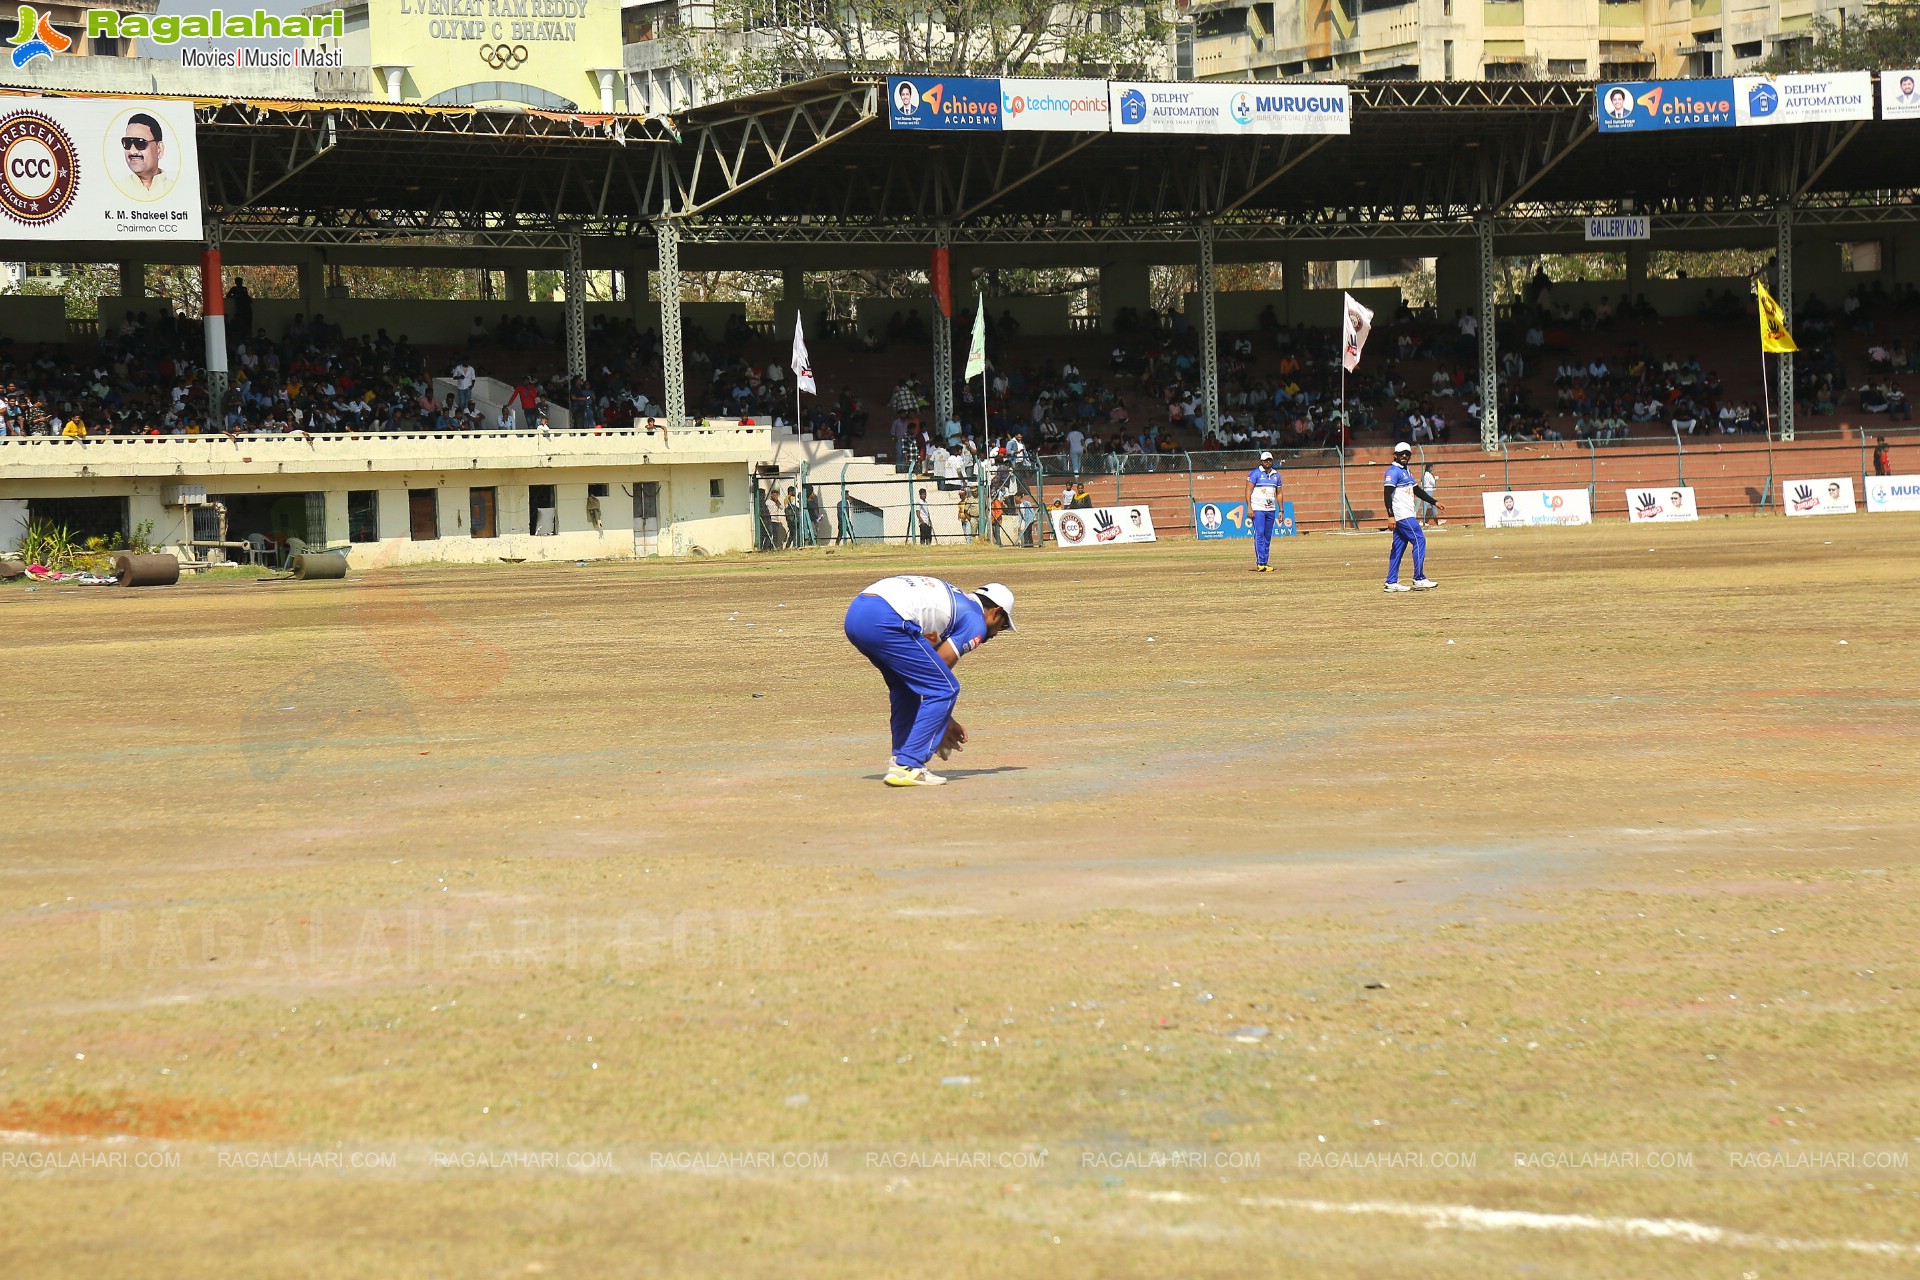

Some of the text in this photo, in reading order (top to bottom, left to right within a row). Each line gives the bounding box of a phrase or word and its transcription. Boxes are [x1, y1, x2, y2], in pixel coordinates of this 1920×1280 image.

[488, 0, 528, 17] RAM
[531, 0, 587, 18] REDDY
[511, 21, 576, 41] BHAVAN
[1782, 83, 1828, 95] DELPHY
[1026, 95, 1108, 115] technopaints
[1151, 93, 1190, 103] DELPHY
[1256, 96, 1344, 113] MURUGUN
[1784, 95, 1862, 108] AUTOMATION
[1153, 107, 1219, 117] AUTOMATION
[1664, 114, 1729, 125] ACADEMY
[945, 115, 998, 125] ACADEMY
[11, 158, 51, 179] CCC
[1, 183, 28, 209] CRICKET
[48, 187, 63, 204] CUP
[104, 210, 114, 220] K.
[117, 210, 129, 220] M.
[131, 210, 169, 220] Shakeel
[116, 223, 178, 233] Chairman CCC
[1590, 219, 1644, 238] GALLERY NO 3
